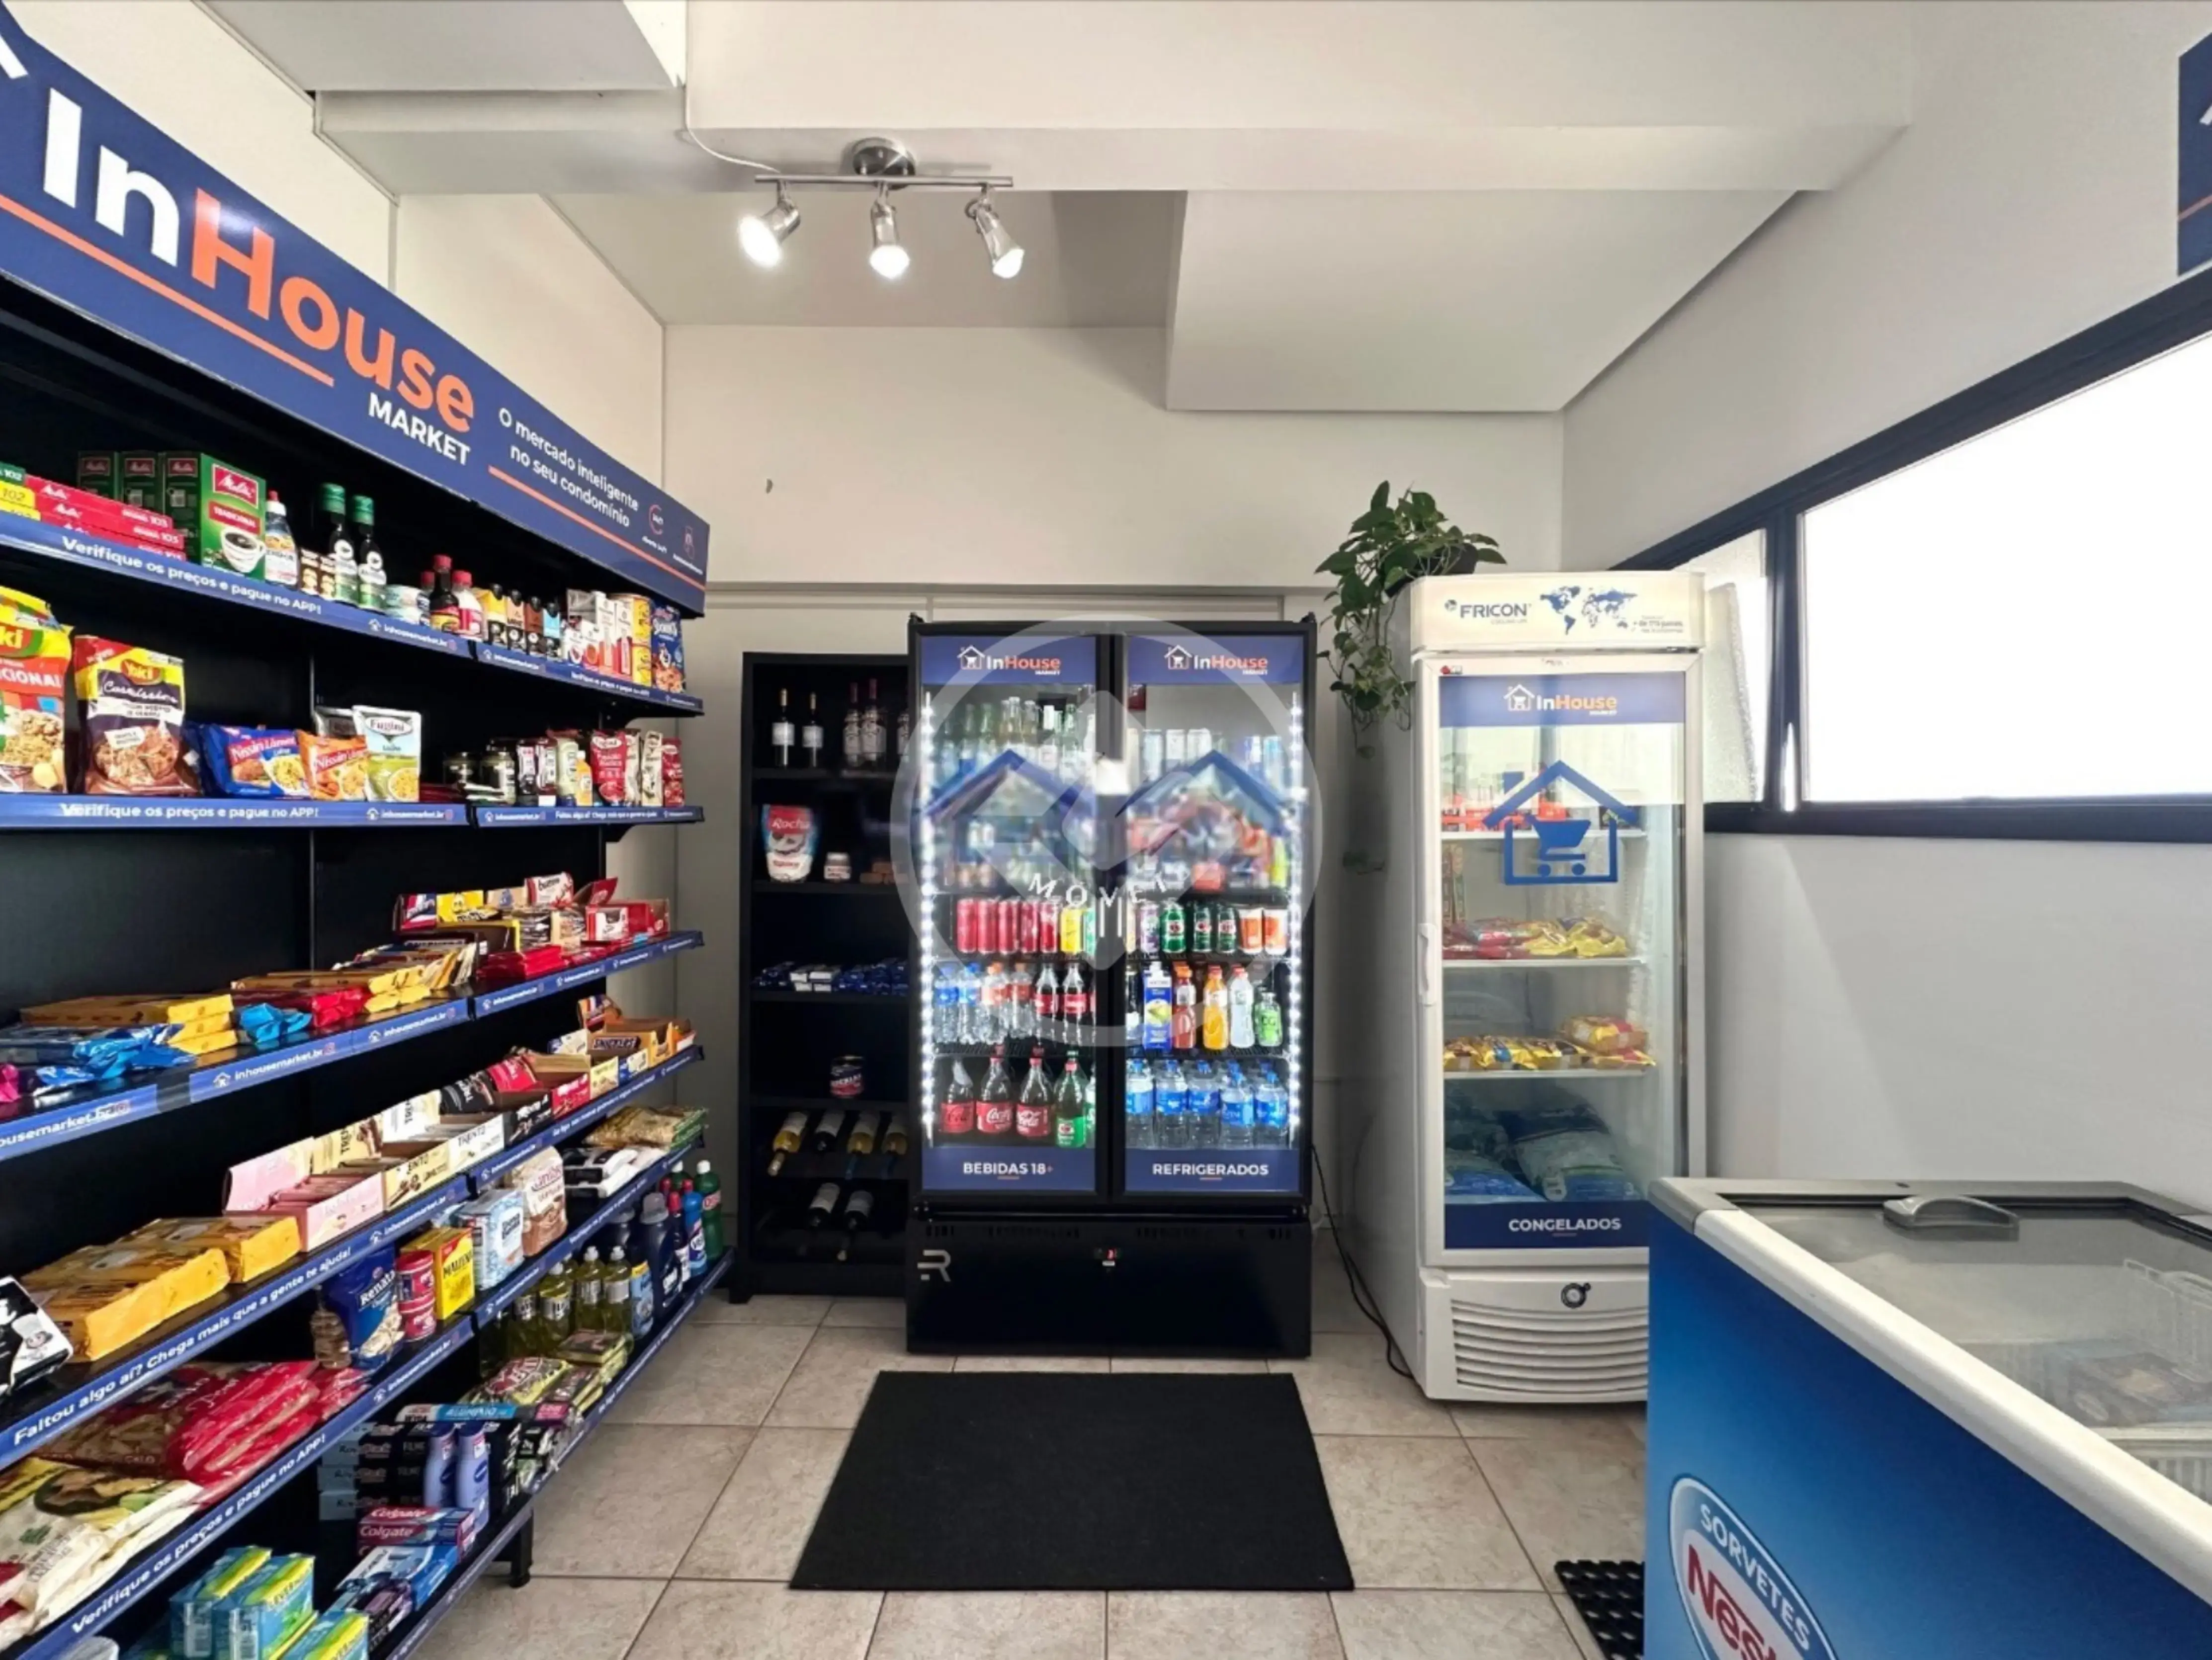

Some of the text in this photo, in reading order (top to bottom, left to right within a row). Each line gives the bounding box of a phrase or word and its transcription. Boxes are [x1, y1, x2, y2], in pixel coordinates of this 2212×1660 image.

[43, 87, 474, 433] InHouse
[368, 392, 471, 466] MARKET
[499, 408, 639, 511] O mercado inteligente
[510, 445, 530, 468] no
[533, 457, 558, 484] seu
[560, 471, 630, 528] condomínio
[62, 535, 143, 569] Verifique
[146, 562, 165, 575] os
[168, 567, 216, 589] preços
[219, 581, 229, 590] e
[231, 581, 271, 603] pague
[273, 593, 291, 607] no
[292, 599, 322, 615] APP!
[1459, 602, 1528, 619] FRICON
[986, 655, 1061, 670] InHouse
[1193, 655, 1269, 670] InHouse
[1536, 694, 1617, 711] InHouse
[369, 719, 405, 735] Fugini
[59, 803, 319, 820] Verifique os preços e pague no APP!
[235, 1049, 323, 1080] inhousemarket.br
[963, 1162, 1054, 1175] BEBIDAS 18+
[1152, 1163, 1270, 1176] REFRIGERADOS
[1508, 1217, 1621, 1232] CONGELADOS
[360, 1269, 396, 1306] Renata
[13, 1247, 351, 1445] Faltou algo aí? Chega mais que a gente te ajuda!
[71, 1569, 150, 1634] Verifique
[153, 1552, 171, 1571] os
[174, 1517, 223, 1559] preços
[225, 1506, 234, 1518] e
[237, 1477, 277, 1511] pague
[279, 1461, 296, 1477] no
[296, 1433, 326, 1463] APP!
[359, 1525, 414, 1540] Colgate
[1700, 1503, 1810, 1651] SORVETES
